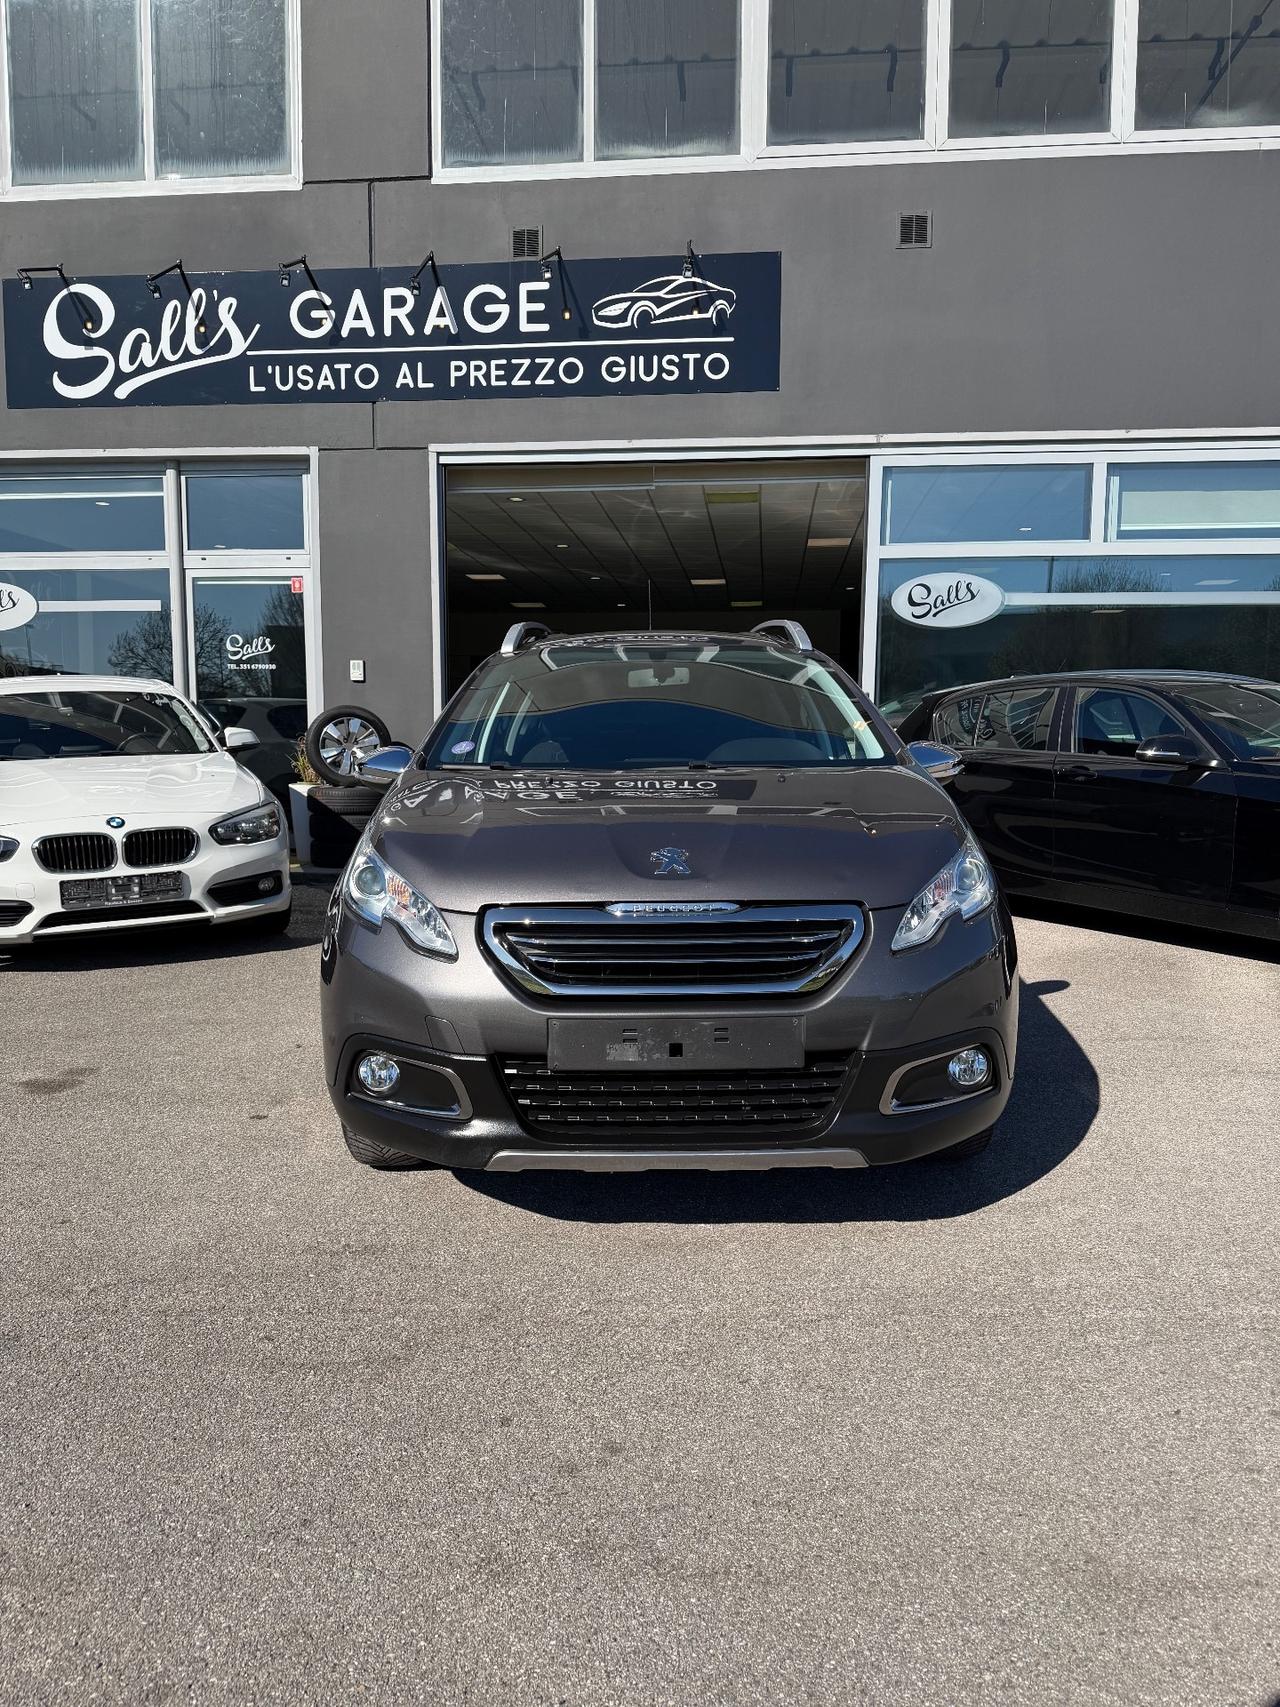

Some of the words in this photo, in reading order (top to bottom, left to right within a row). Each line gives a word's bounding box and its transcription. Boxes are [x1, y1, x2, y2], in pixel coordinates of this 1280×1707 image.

[43, 283, 261, 400] Sall's
[289, 281, 550, 339] GARAGE
[249, 363, 380, 392] L'USATO
[395, 362, 434, 388] AL
[450, 357, 584, 387] PREZZO
[601, 353, 730, 383] GIUSTO
[907, 580, 980, 619] Sall's
[226, 634, 276, 660] Sall's
[633, 904, 715, 912] PEUGEOT
